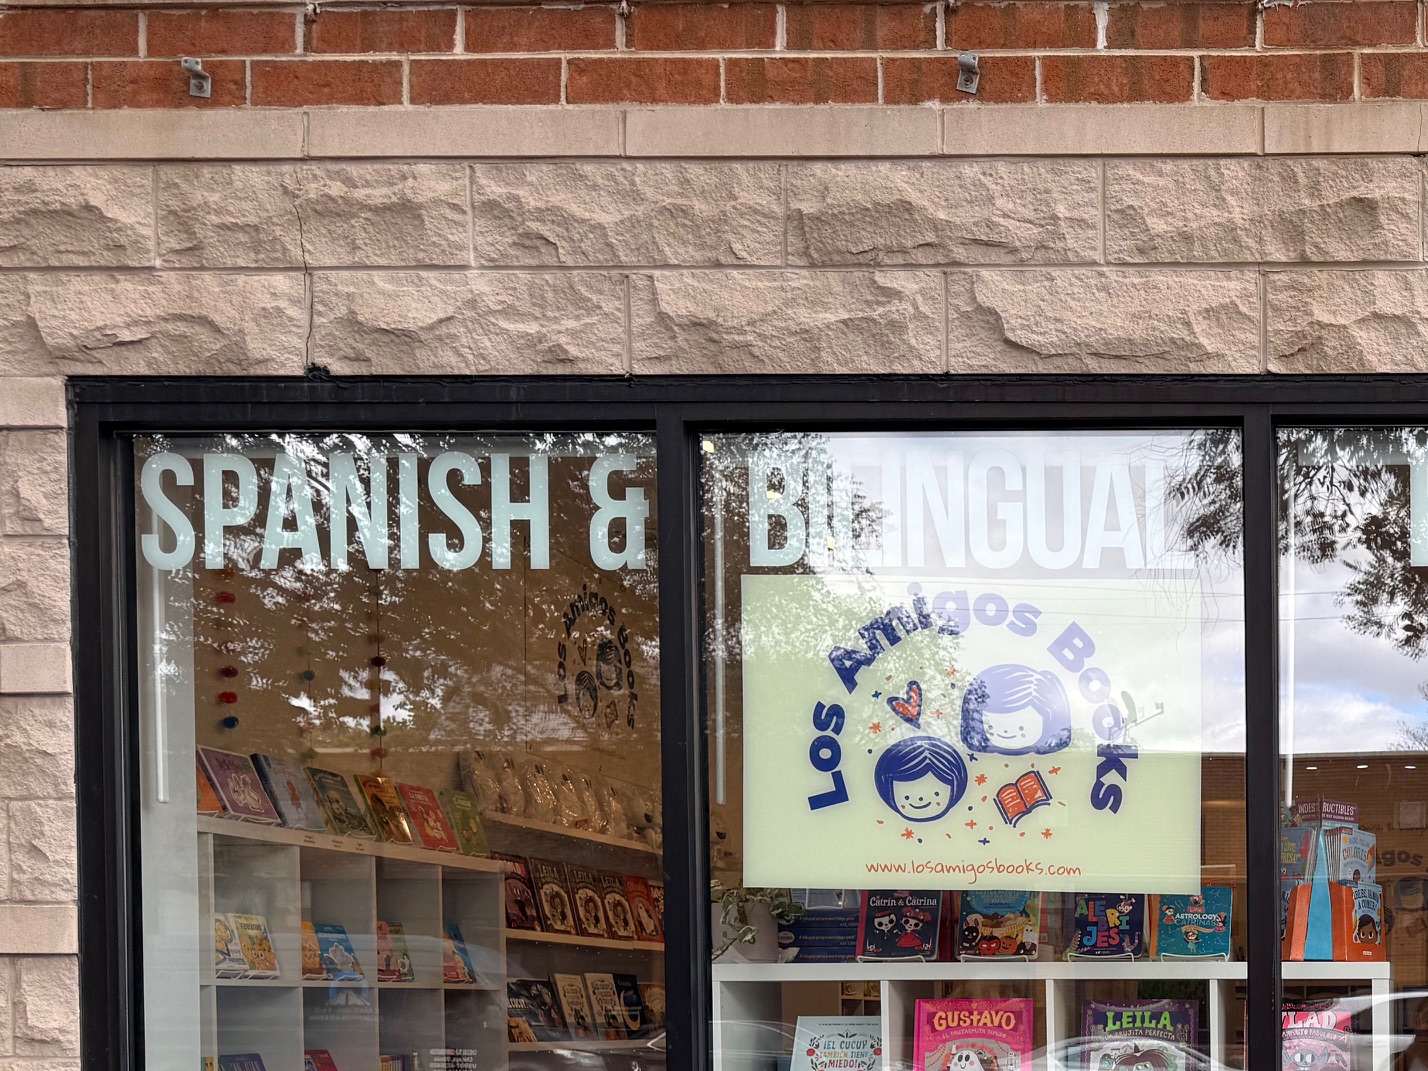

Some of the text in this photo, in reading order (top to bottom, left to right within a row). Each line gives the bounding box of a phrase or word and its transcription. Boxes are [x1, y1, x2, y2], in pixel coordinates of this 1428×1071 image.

[140, 453, 650, 571] SPANISH &
[748, 450, 1195, 570] BILINGUAL
[807, 582, 1139, 815] Los Amigos Books
[865, 858, 1082, 884] www.losamigosbooks.com
[933, 1010, 1016, 1031] GUSTAVO
[1105, 1011, 1174, 1032] LEILA
[840, 1040, 868, 1050] CUCUY
[1145, 1029, 1175, 1040] PERFECTA
[828, 1059, 858, 1068] MIEDO!
